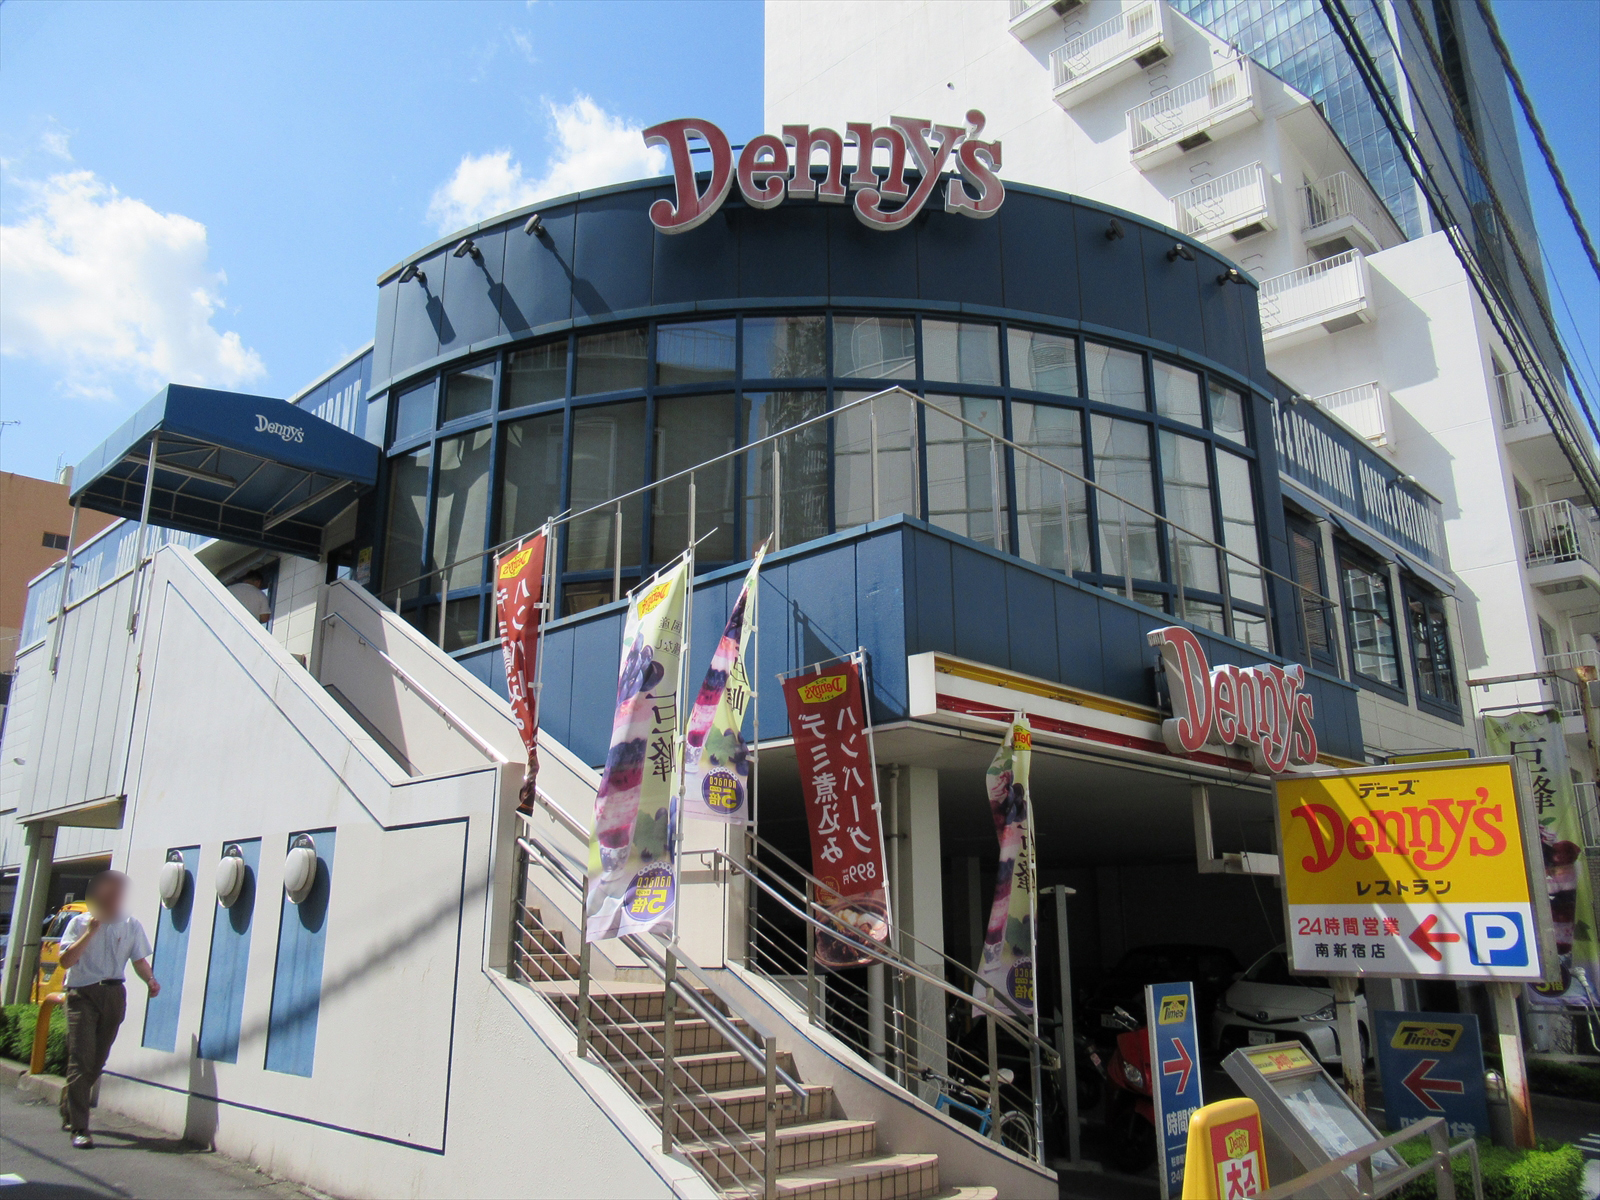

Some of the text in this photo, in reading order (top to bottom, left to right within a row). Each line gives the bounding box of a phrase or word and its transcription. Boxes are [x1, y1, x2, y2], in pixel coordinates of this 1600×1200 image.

[641, 109, 1006, 235] Denny's
[254, 414, 305, 443] Denny's
[1291, 409, 1355, 501] RESTAURANT
[1359, 459, 1392, 526] COFFEE
[1147, 626, 1317, 773] Denny's
[1358, 780, 1420, 798] デニーズ
[1290, 786, 1507, 873] Denny's
[1356, 879, 1452, 896] レストラン
[1297, 916, 1401, 937] 24時間営業
[1314, 943, 1386, 959] 南新宿店
[1164, 1005, 1184, 1020] Times
[1403, 1032, 1452, 1047] Times
[1166, 1107, 1198, 1136] 時間
